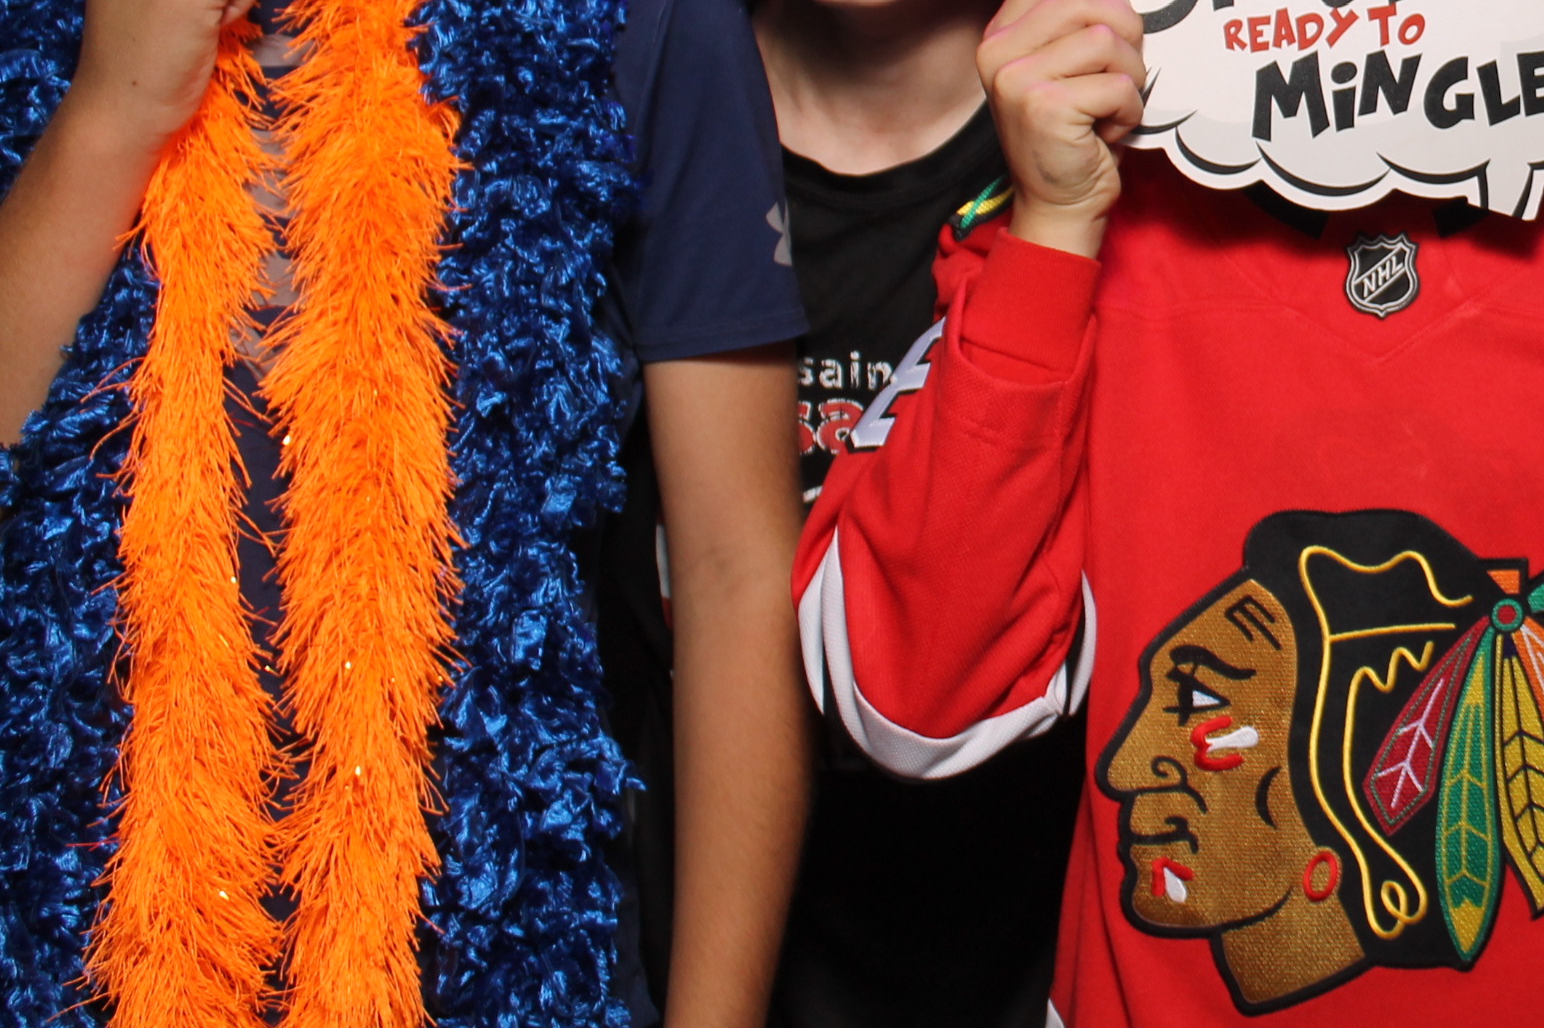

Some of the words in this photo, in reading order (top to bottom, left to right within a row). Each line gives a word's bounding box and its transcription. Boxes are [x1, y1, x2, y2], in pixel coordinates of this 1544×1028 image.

[1223, 7, 1359, 53] READY
[1367, 2, 1425, 47] TO
[1362, 255, 1404, 298] NHL
